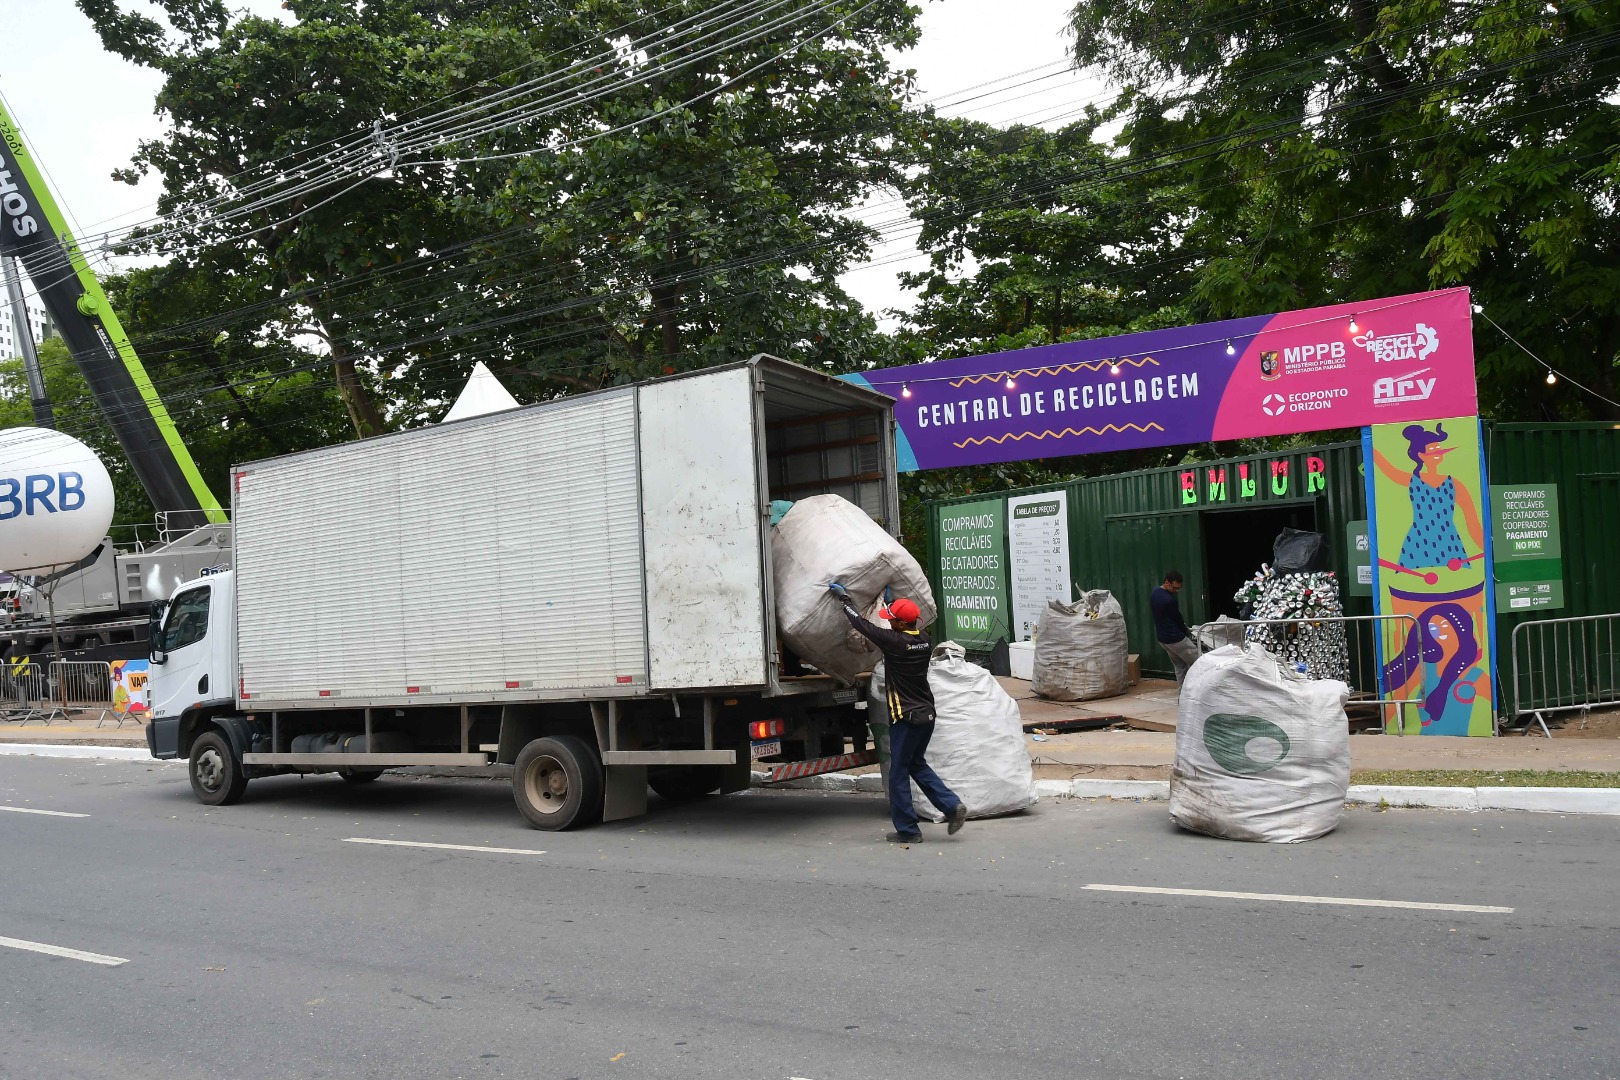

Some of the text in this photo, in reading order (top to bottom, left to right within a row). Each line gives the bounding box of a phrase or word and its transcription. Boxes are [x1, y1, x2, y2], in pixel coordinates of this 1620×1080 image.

[1366, 334, 1427, 352] RECICLA
[1284, 341, 1346, 363] MPPB
[1375, 347, 1416, 362] FOLIA
[1320, 358, 1346, 366] PÚBLICO
[1289, 388, 1349, 402] ECOPONTO
[1374, 377, 1437, 400] Ary
[918, 372, 1199, 428] CENTRAL DE RECICLAGEM
[1289, 400, 1332, 412] ORIZON
[0, 472, 85, 520] BRB
[1503, 491, 1546, 499] COMPRAMOS
[1506, 499, 1545, 509] RECICLÁVEIS
[1502, 510, 1549, 520] DE CATADORES
[942, 514, 994, 532] COMPRAMOS
[945, 532, 992, 551] RECICLÁVEIS
[1506, 530, 1548, 540] PAGAMENTO
[1515, 541, 1527, 550] NO
[941, 557, 951, 571] DE
[952, 555, 999, 570] CATADORES
[946, 596, 998, 610] PAGAMENTO
[956, 615, 988, 630] NO PIX!
